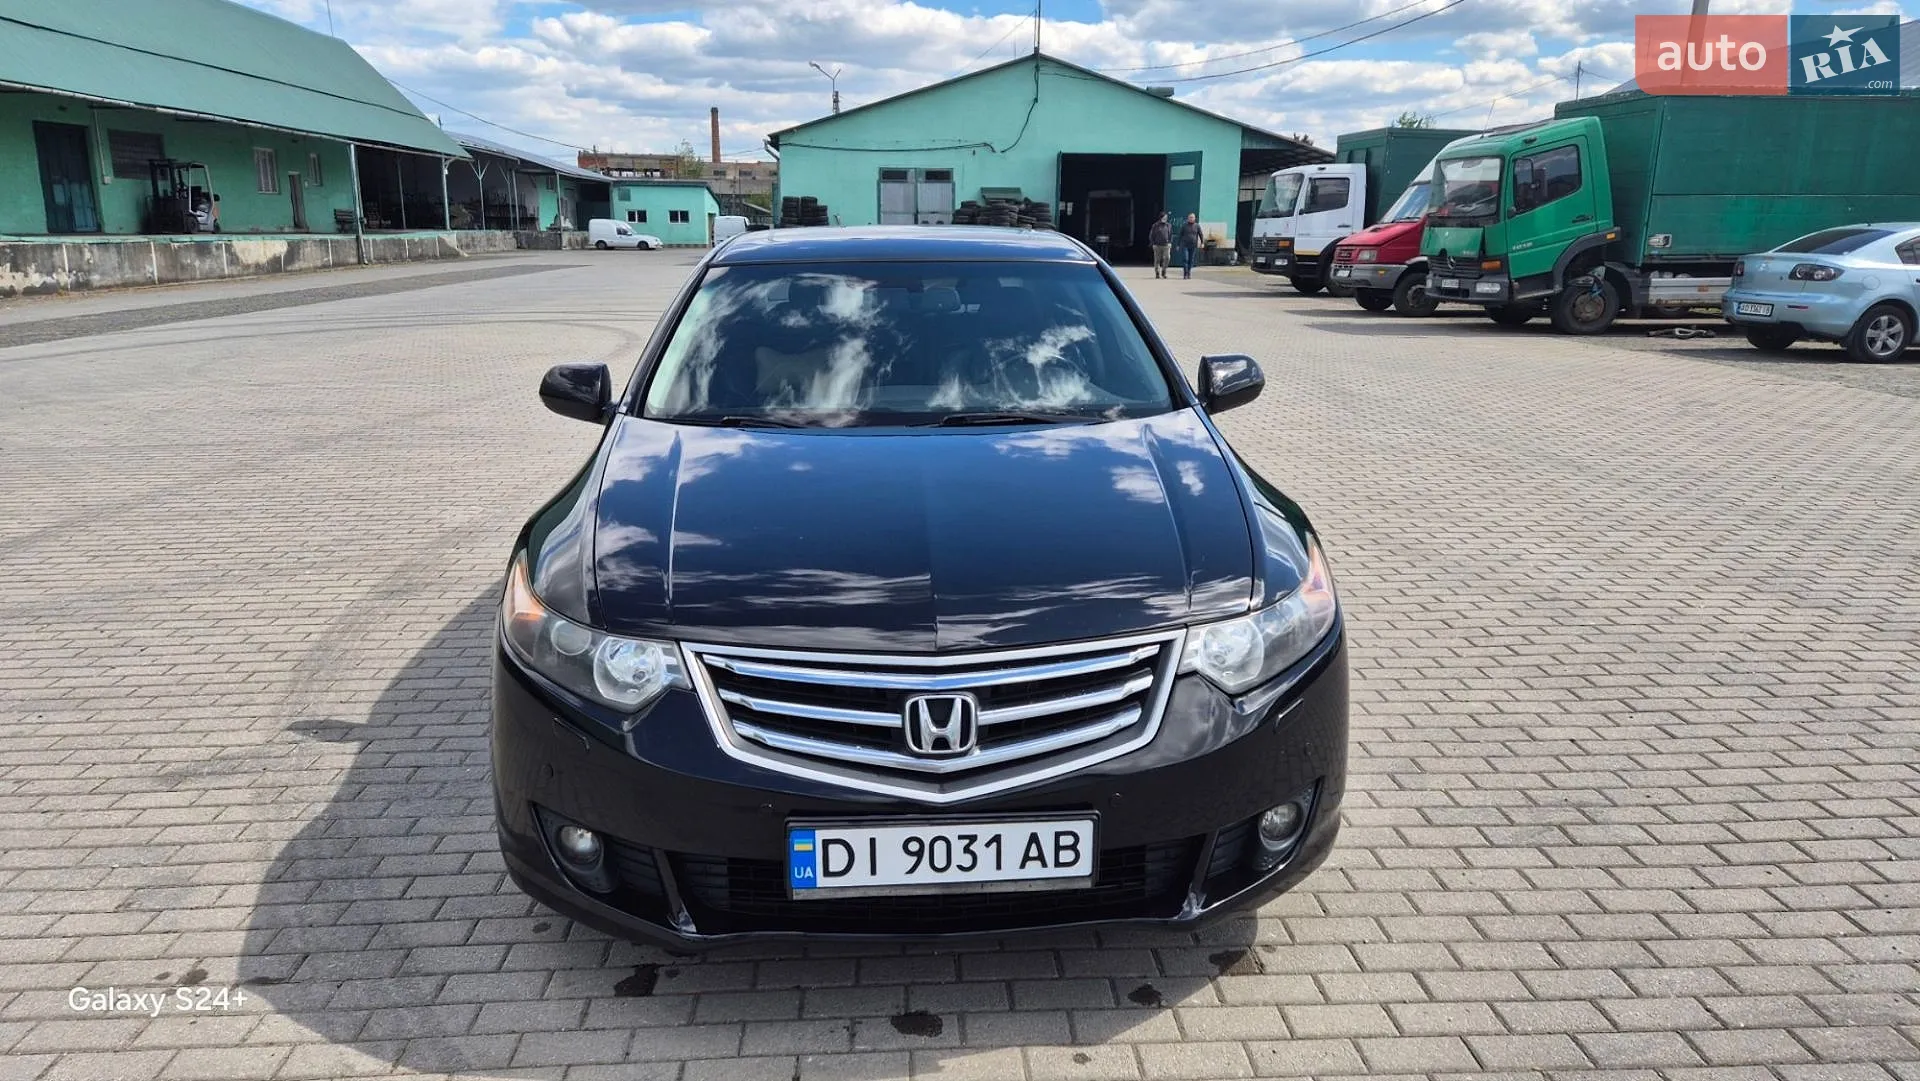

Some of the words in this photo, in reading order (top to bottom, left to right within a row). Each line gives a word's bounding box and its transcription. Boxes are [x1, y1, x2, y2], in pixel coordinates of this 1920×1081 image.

[821, 837, 878, 877] DI
[902, 833, 1003, 875] 9031
[1019, 830, 1081, 869] AB
[794, 867, 814, 879] UA
